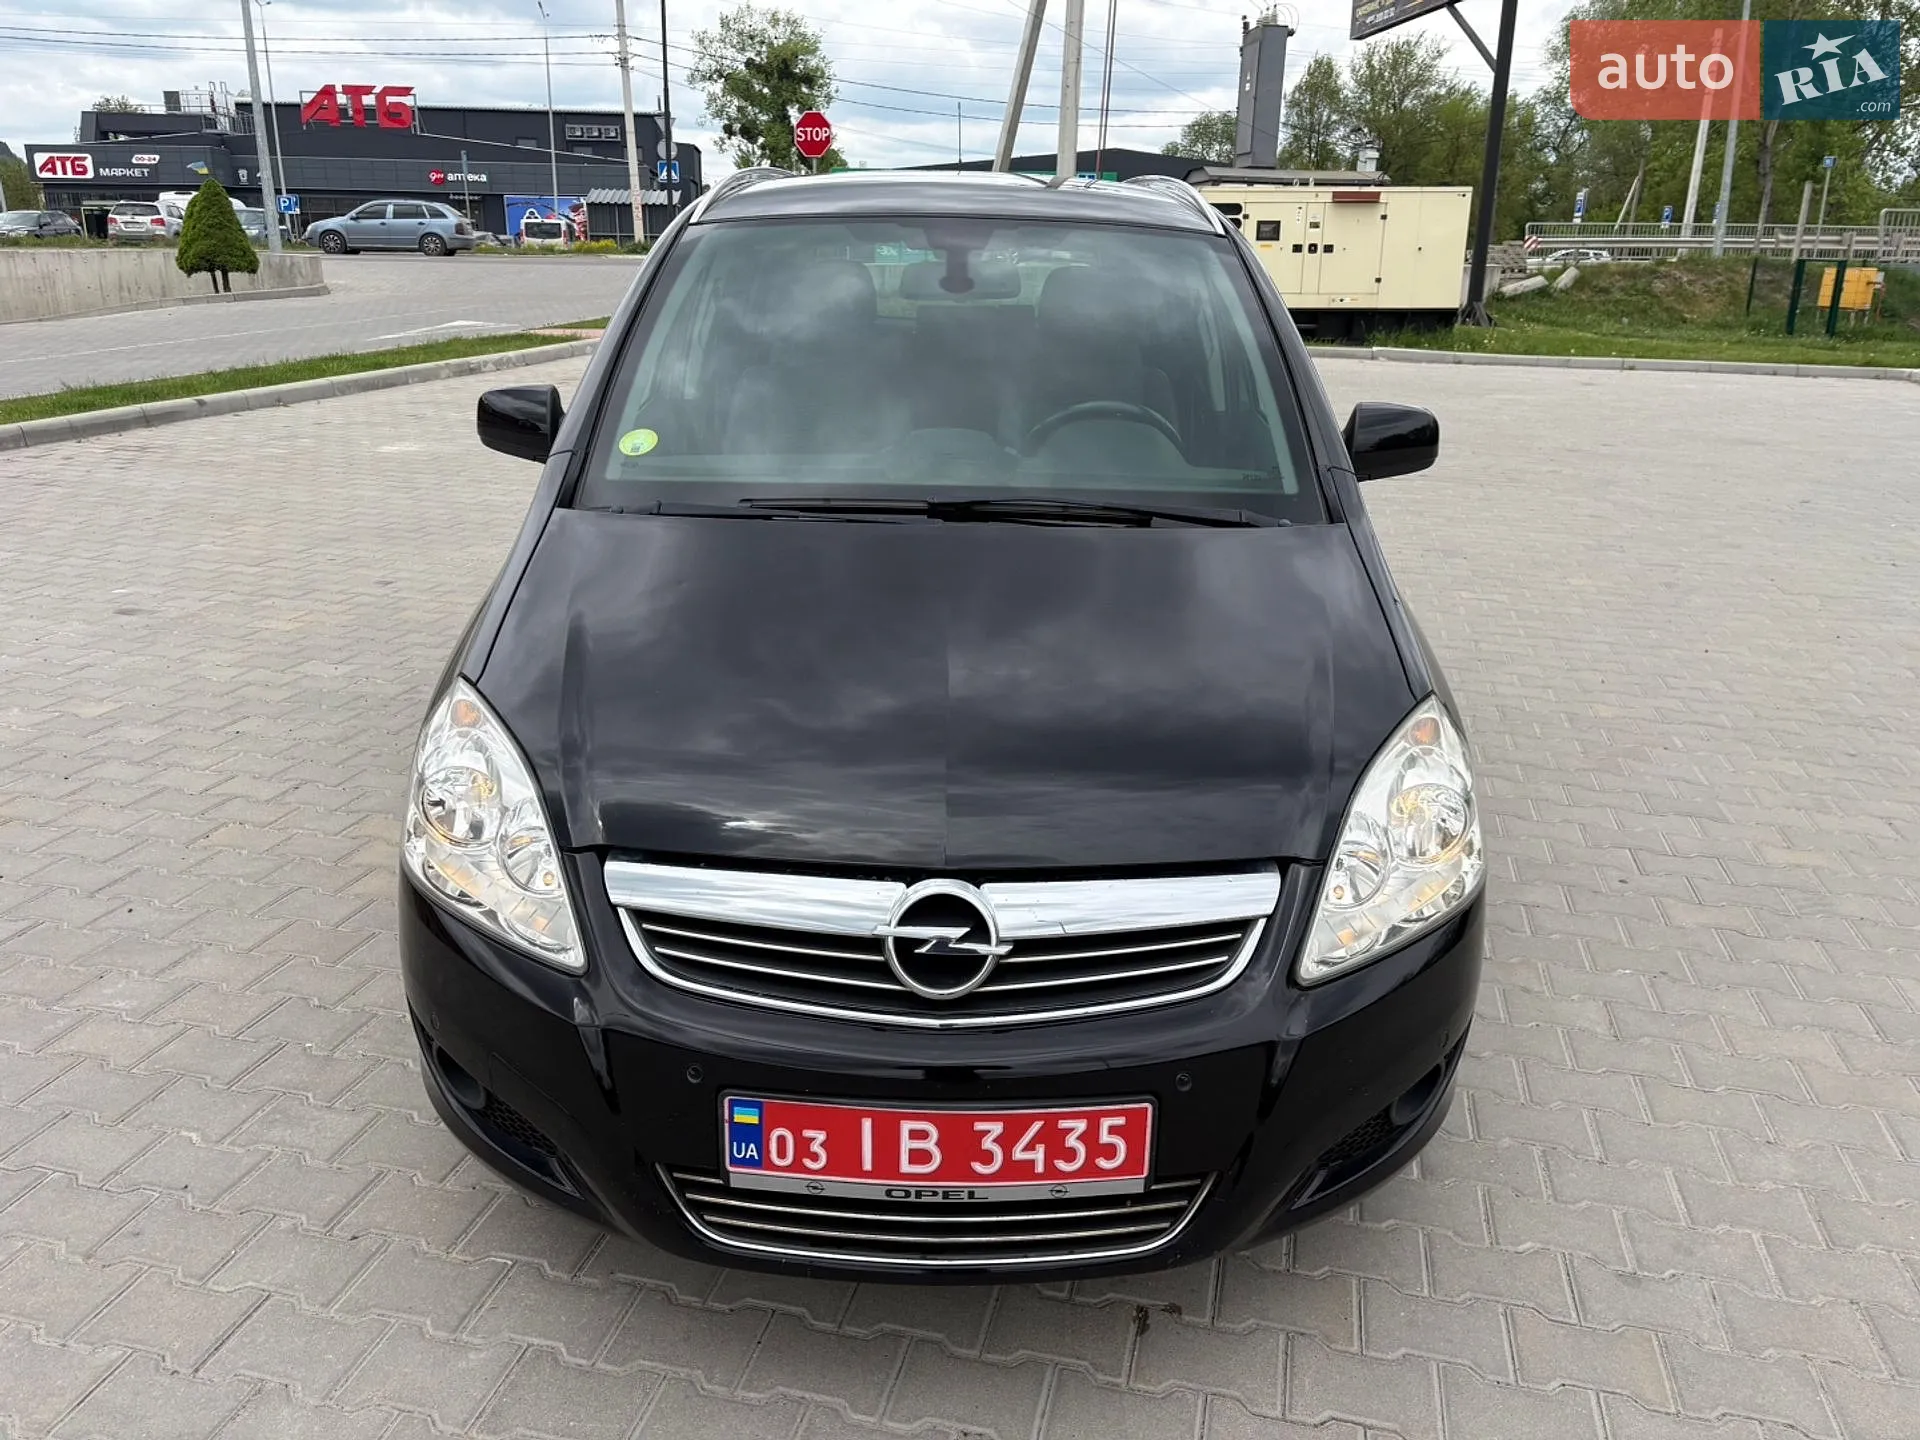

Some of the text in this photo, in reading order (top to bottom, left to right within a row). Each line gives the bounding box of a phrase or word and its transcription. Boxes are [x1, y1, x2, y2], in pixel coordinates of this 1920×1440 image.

[797, 127, 829, 141] STOP
[733, 1141, 760, 1160] UA
[768, 1127, 829, 1170] 03
[970, 1117, 1128, 1174] 3435
[884, 1188, 989, 1201] OPEL
